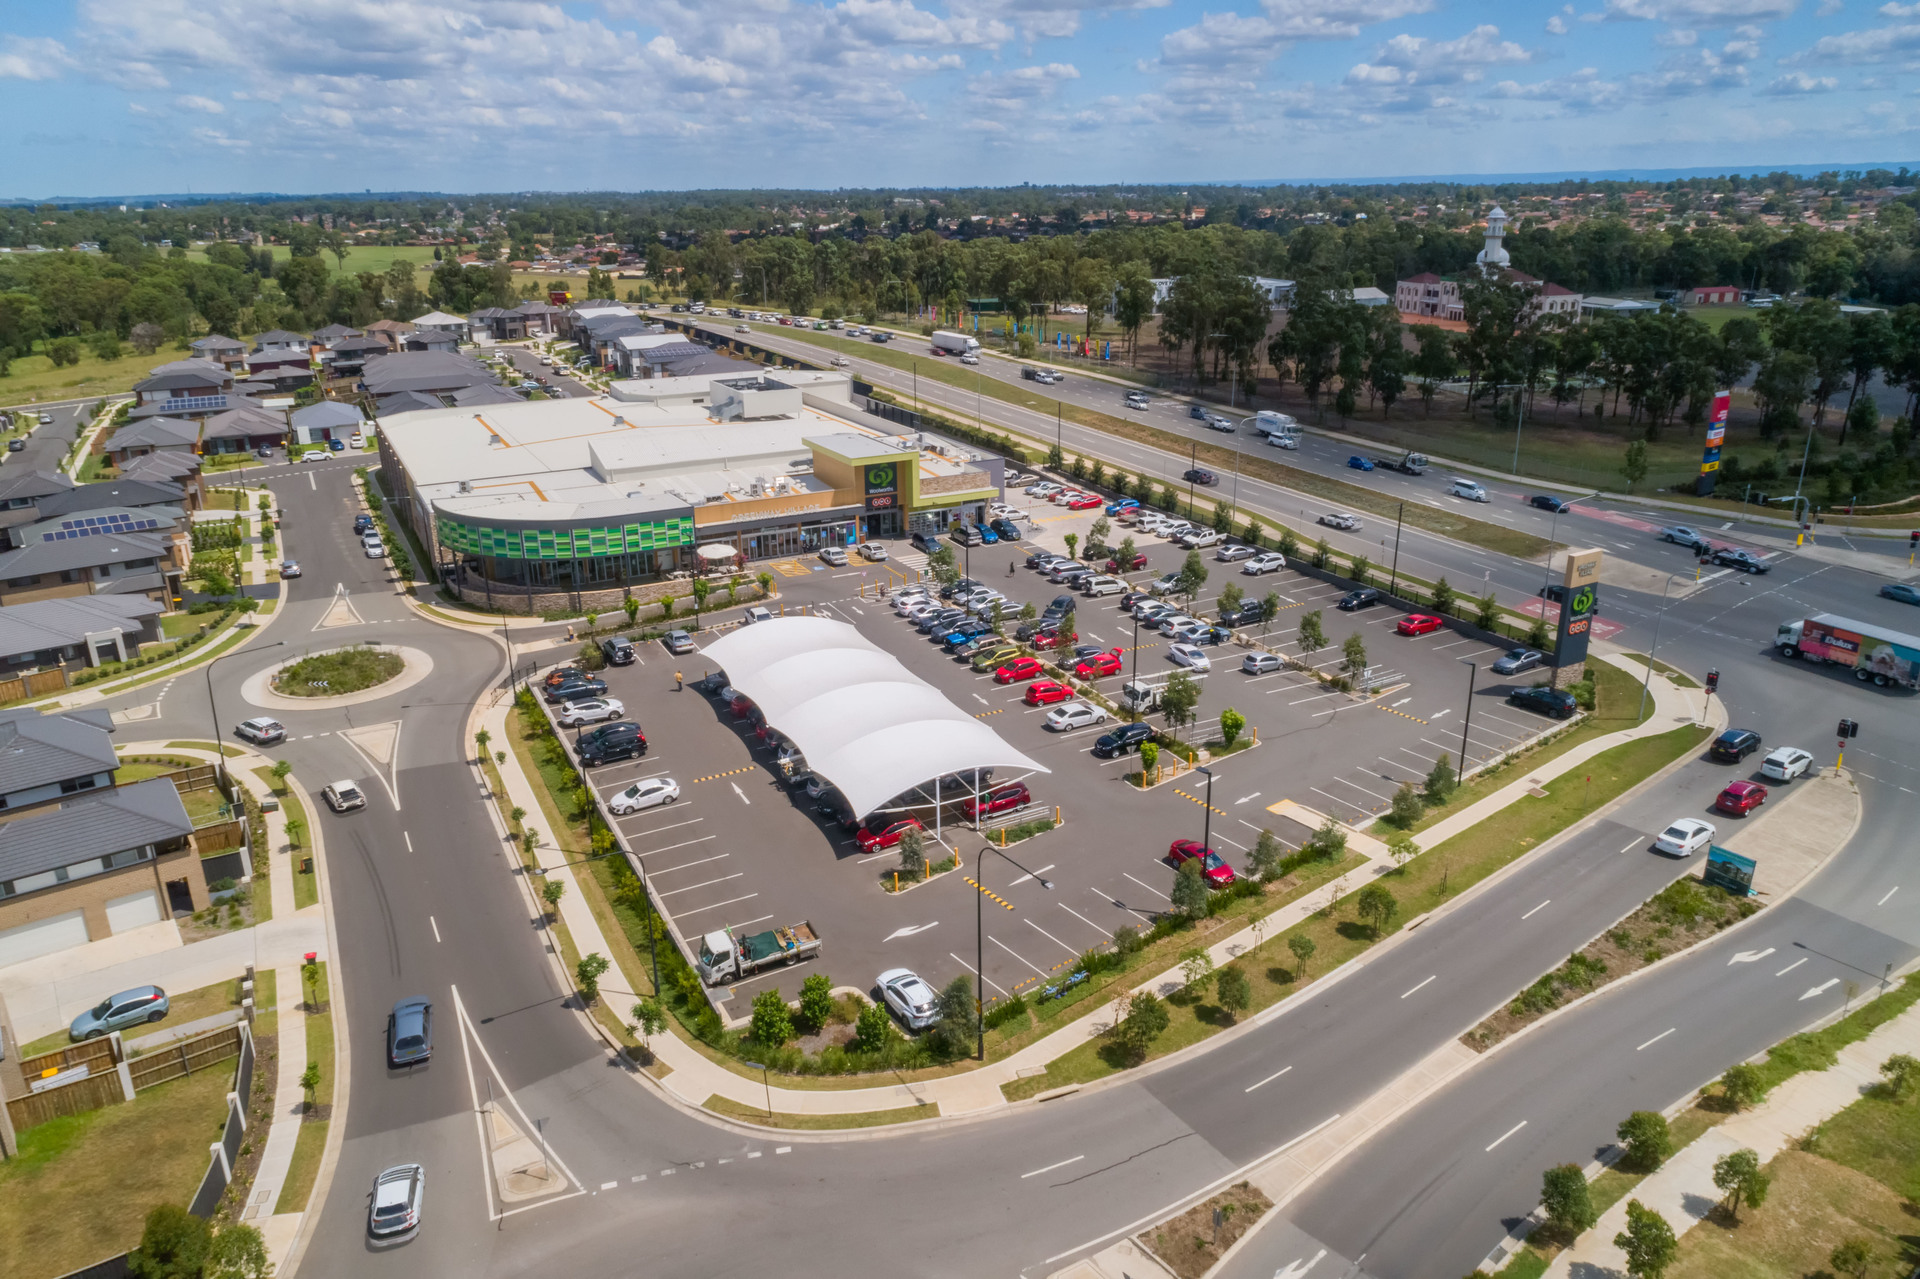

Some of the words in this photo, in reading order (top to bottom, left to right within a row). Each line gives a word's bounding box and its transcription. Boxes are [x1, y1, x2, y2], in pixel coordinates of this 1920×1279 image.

[731, 508, 781, 523] GREENWAY
[784, 504, 821, 514] VILLAGE
[1825, 636, 1853, 650] Dulux
